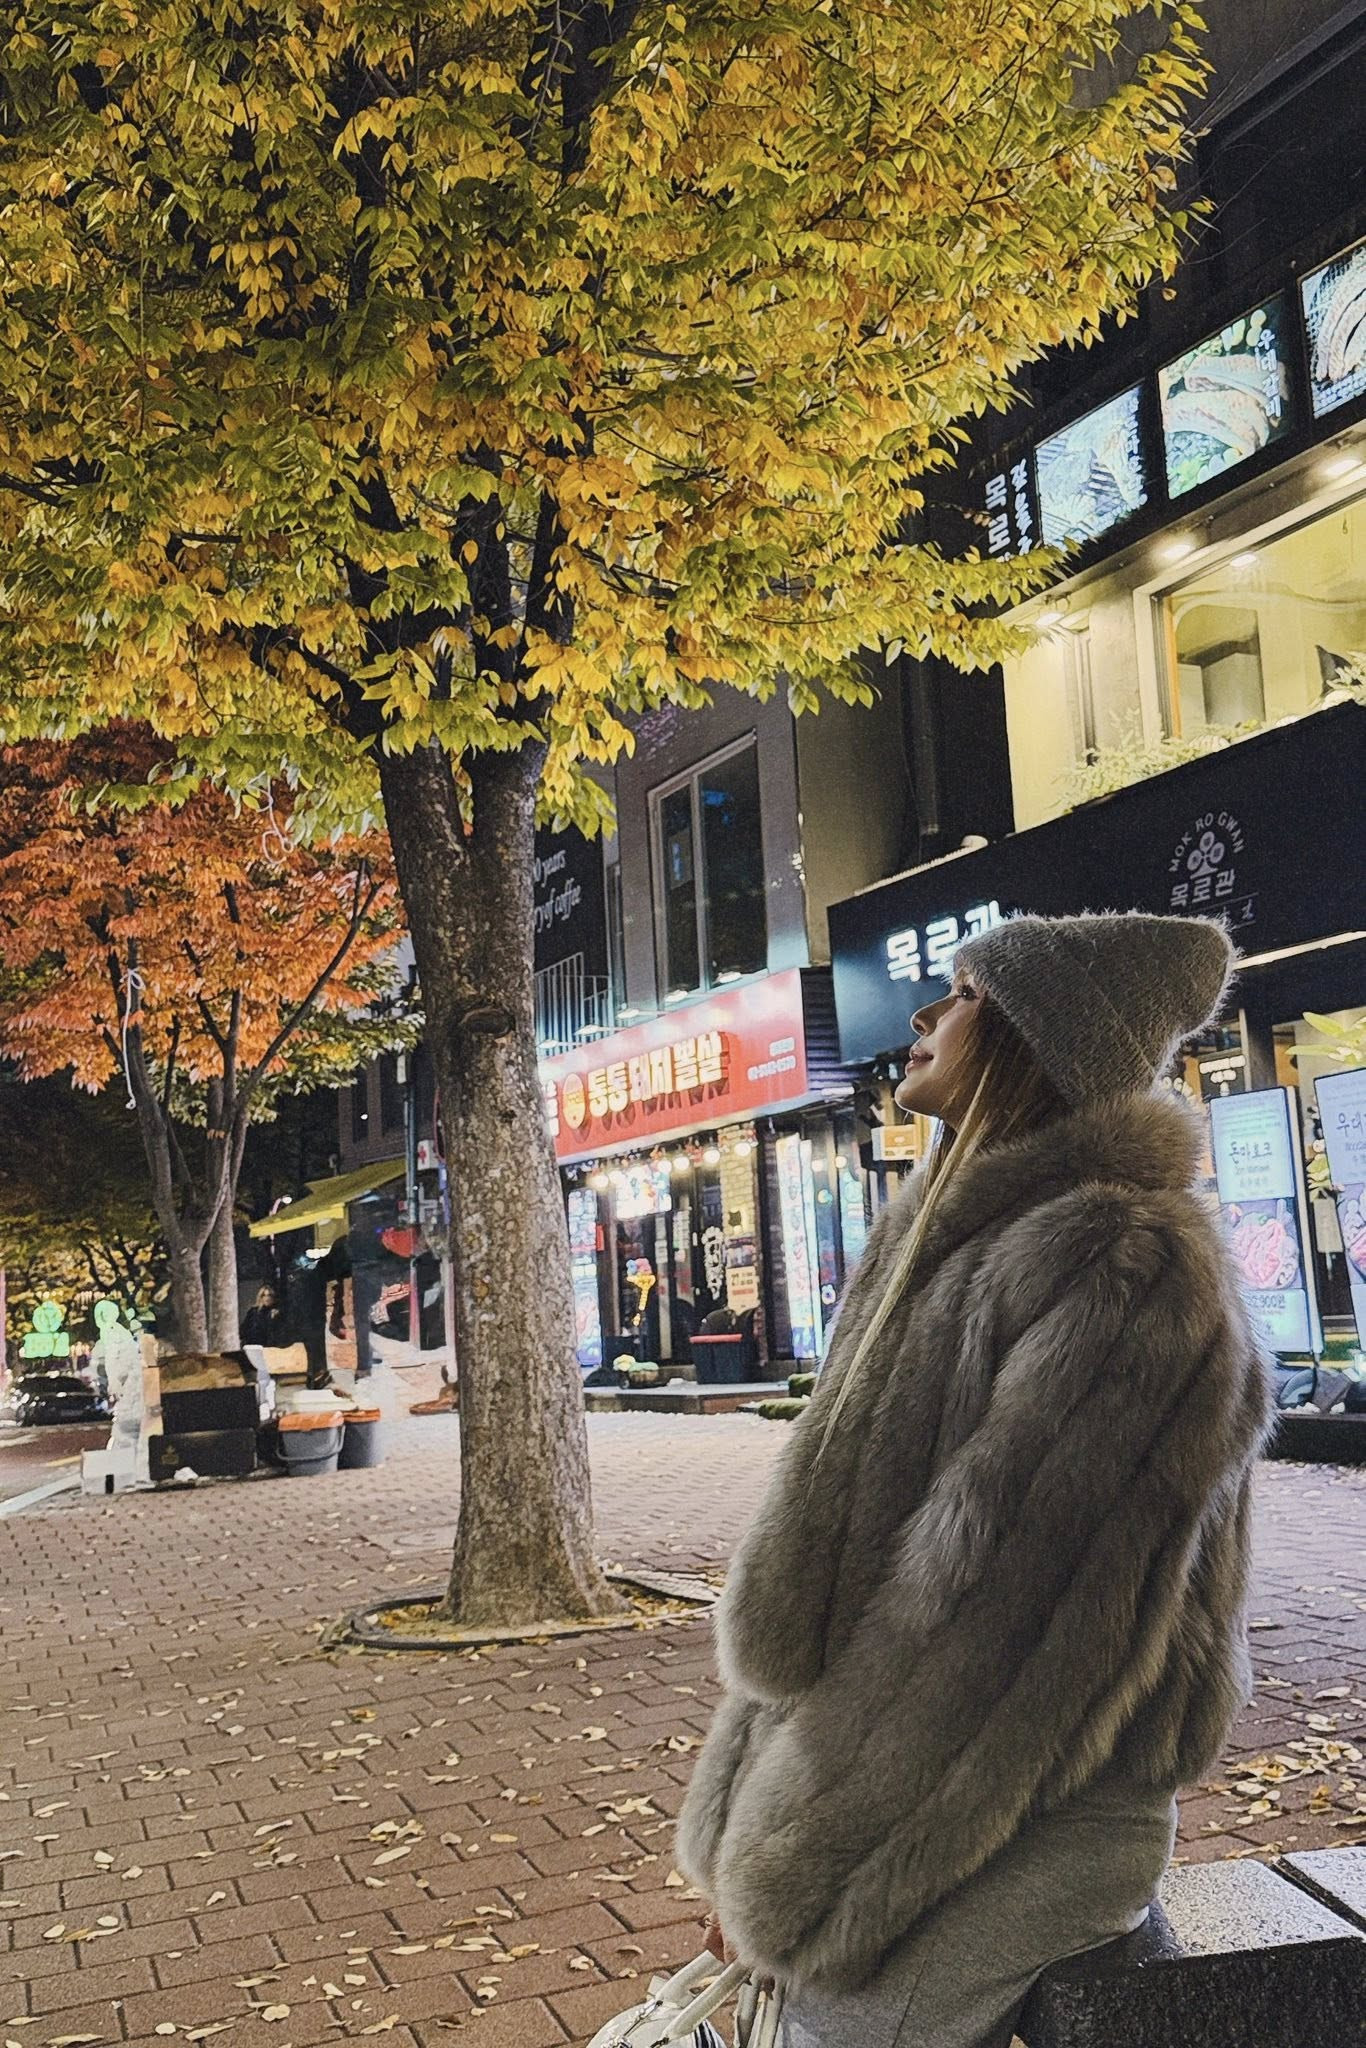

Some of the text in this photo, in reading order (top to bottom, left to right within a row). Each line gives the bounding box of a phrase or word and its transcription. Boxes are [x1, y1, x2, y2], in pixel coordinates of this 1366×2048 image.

[1168, 811, 1245, 872] MOK RO GWAN
[541, 849, 567, 889] years
[1169, 867, 1237, 907] 목로관
[554, 877, 582, 921] coffee
[1336, 1111, 1366, 1139] 우대
